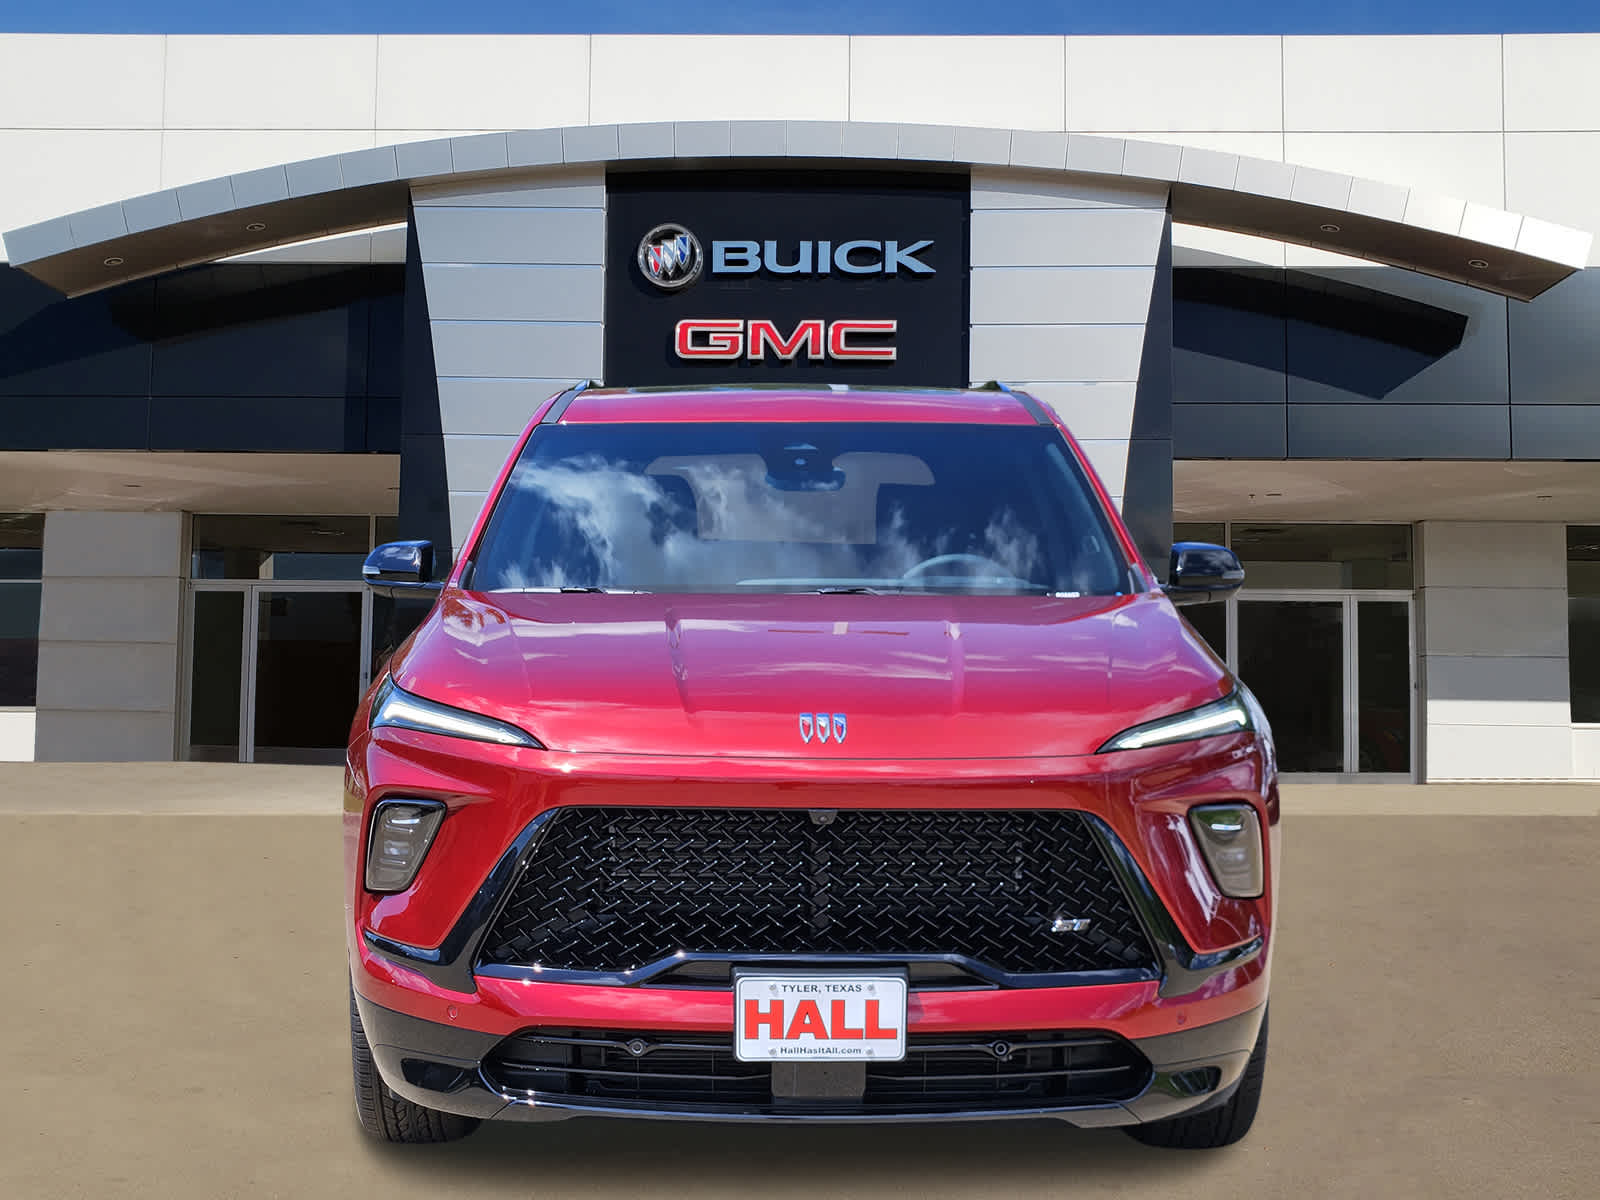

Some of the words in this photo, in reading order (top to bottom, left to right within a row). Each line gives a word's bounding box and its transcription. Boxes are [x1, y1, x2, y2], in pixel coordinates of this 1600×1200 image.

[712, 240, 937, 273] BUICK
[674, 319, 898, 360] GMC
[781, 984, 822, 993] TYLER,
[824, 984, 862, 993] TEXAS
[744, 999, 898, 1040] HALL
[780, 1047, 862, 1055] HallHasItAll.com
